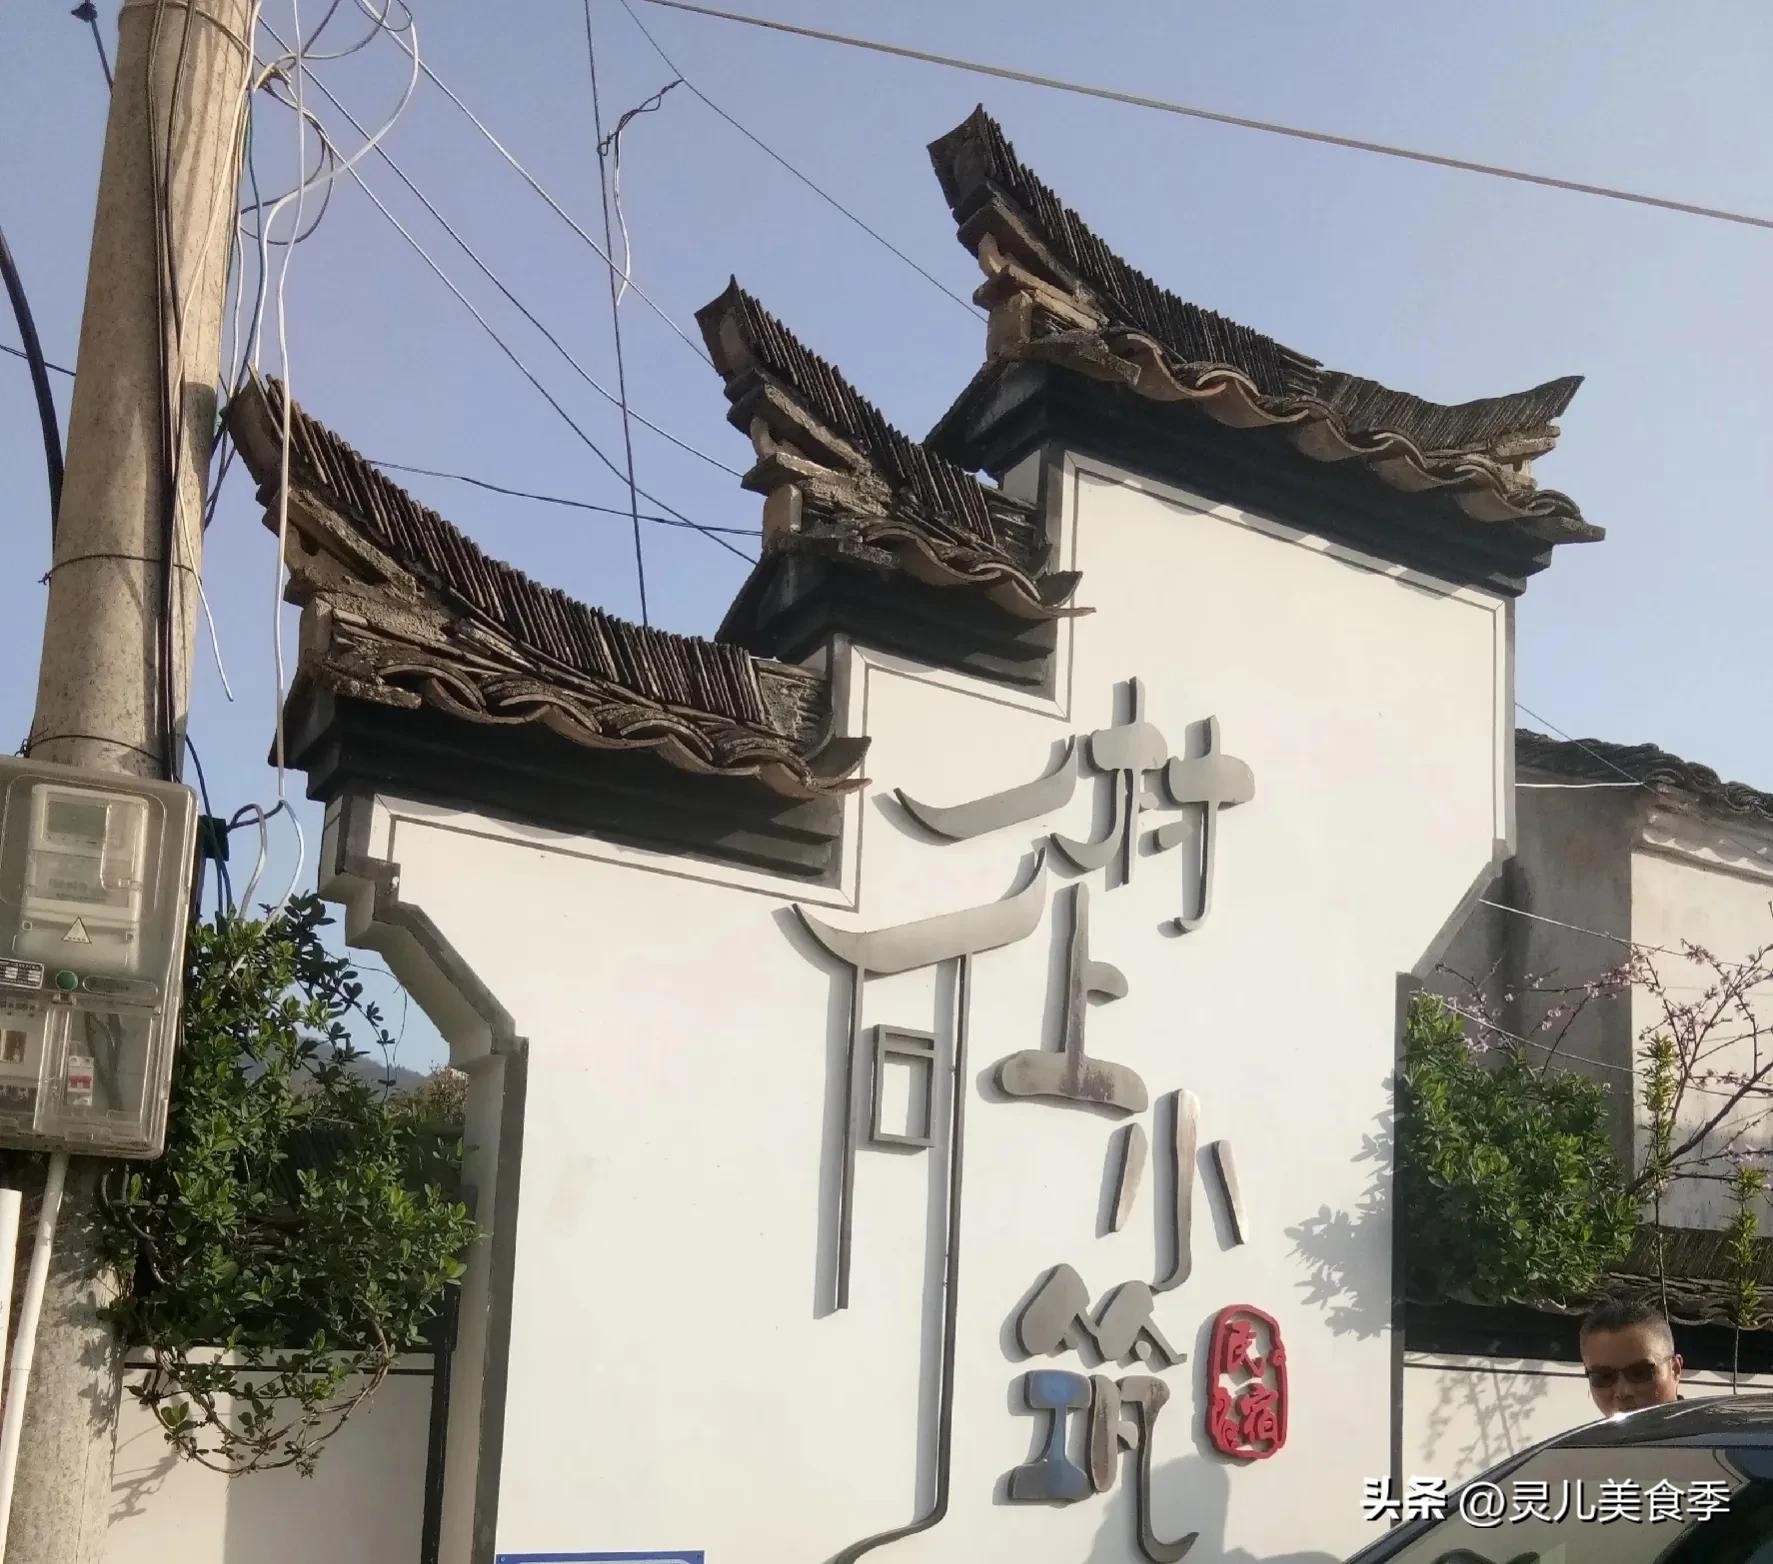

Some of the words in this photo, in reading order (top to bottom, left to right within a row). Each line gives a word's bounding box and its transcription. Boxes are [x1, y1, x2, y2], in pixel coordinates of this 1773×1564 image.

[996, 676, 1255, 1563] 村上小筑
[1222, 1319, 1280, 1446] 民宿
